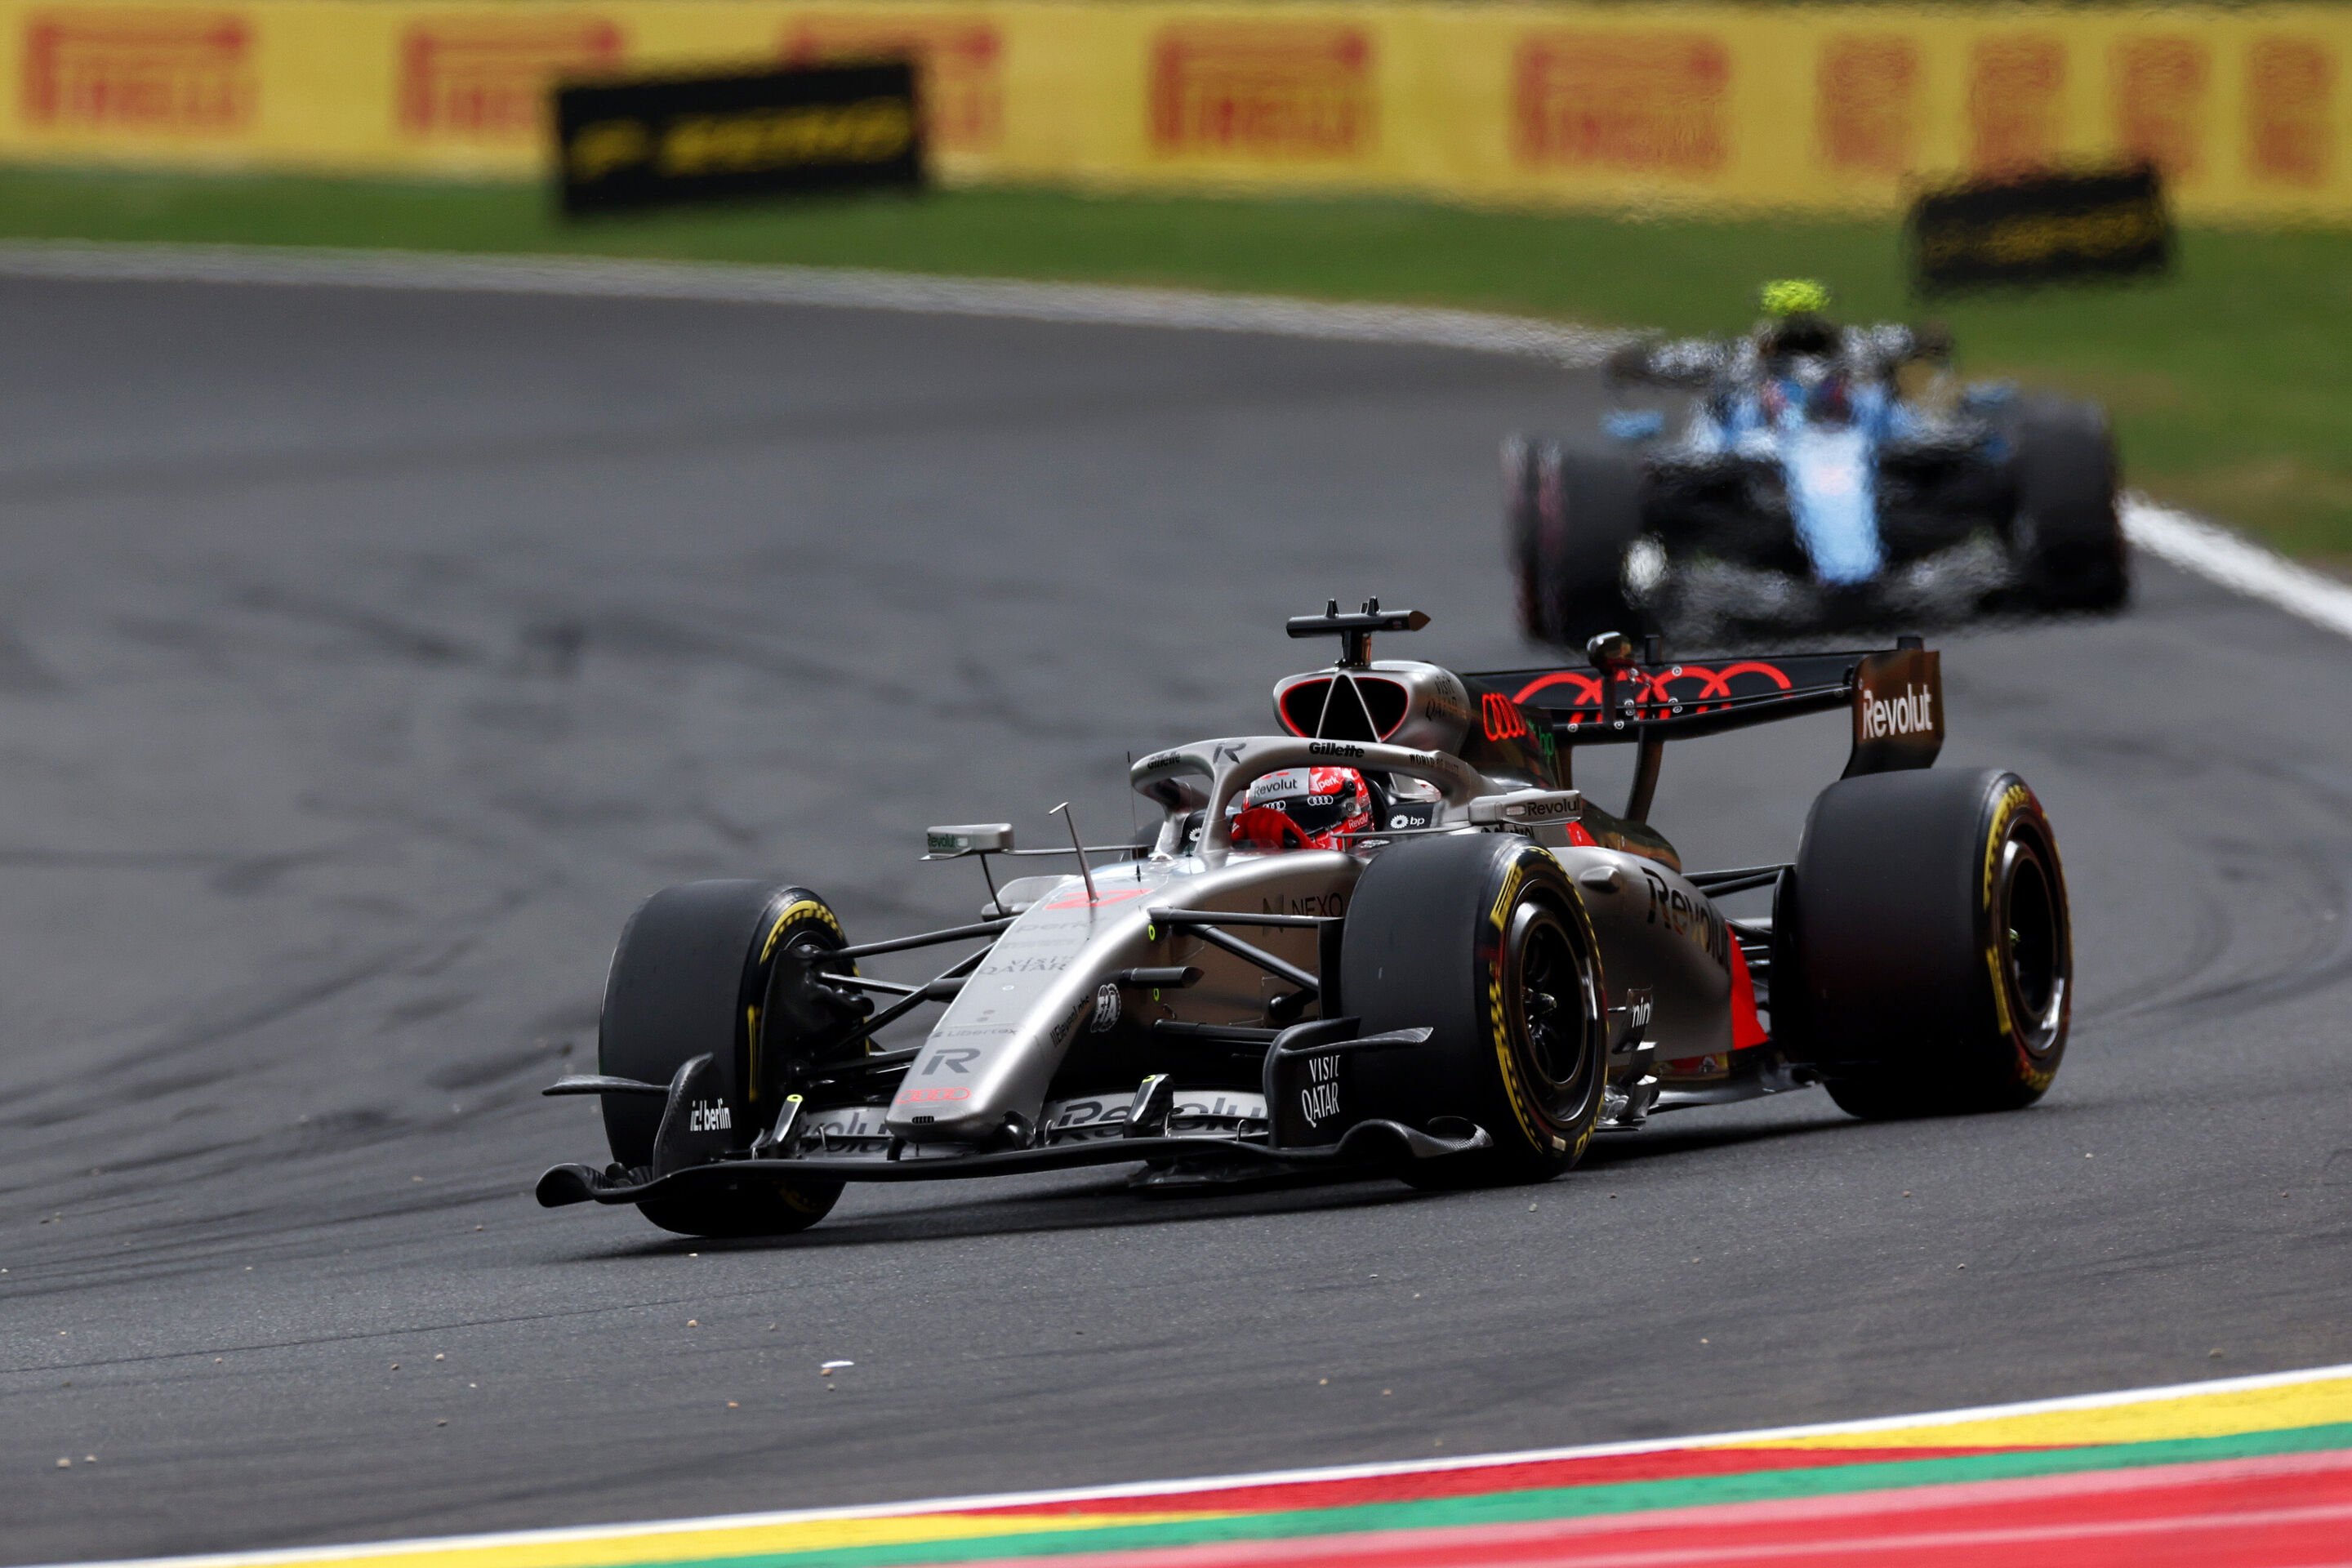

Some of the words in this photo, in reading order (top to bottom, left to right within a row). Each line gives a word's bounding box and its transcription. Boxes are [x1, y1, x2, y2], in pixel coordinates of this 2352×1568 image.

[1863, 682, 1933, 739] Revolut
[1309, 742, 1365, 759] Gillette
[1254, 778, 1298, 798] Revolut
[1318, 775, 1339, 793] perk
[1410, 816, 1425, 826] bp
[1291, 892, 1343, 917] NEXO
[921, 1048, 981, 1076] R
[1309, 1054, 1340, 1083] VISIT
[704, 1098, 732, 1130] berlin
[1302, 1082, 1340, 1128] QATAR
